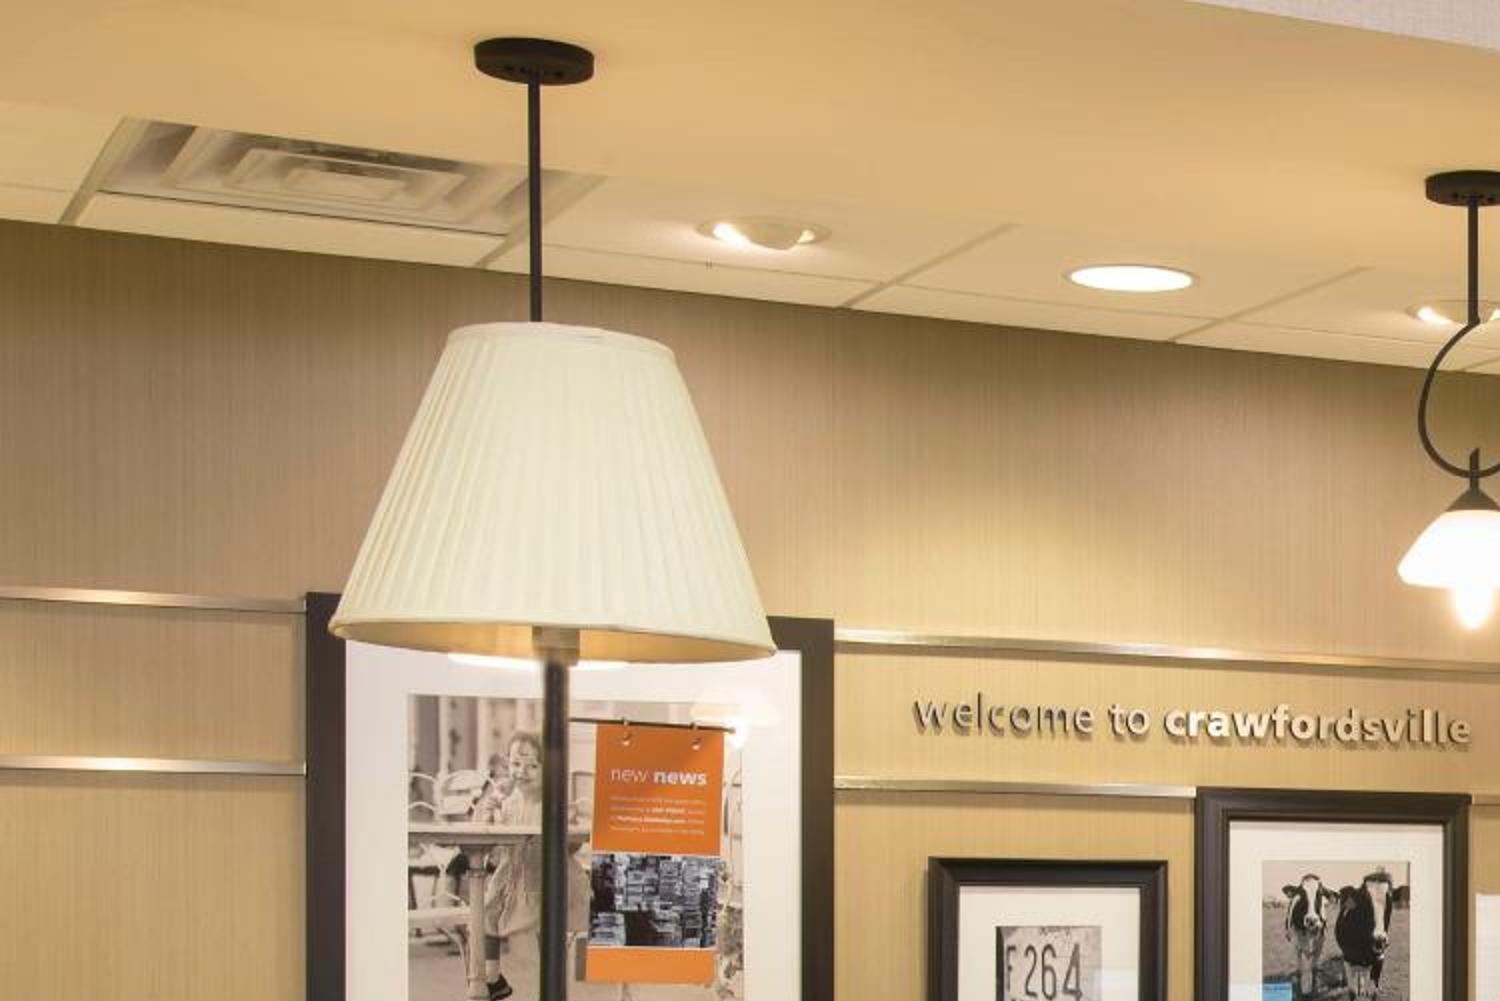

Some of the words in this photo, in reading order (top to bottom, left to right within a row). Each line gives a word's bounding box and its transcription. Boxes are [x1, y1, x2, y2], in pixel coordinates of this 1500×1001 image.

[913, 692, 1095, 735] welcome
[1107, 702, 1151, 737] to
[1162, 705, 1473, 746] crawfordsville
[610, 767, 649, 783] new
[653, 771, 707, 786] news
